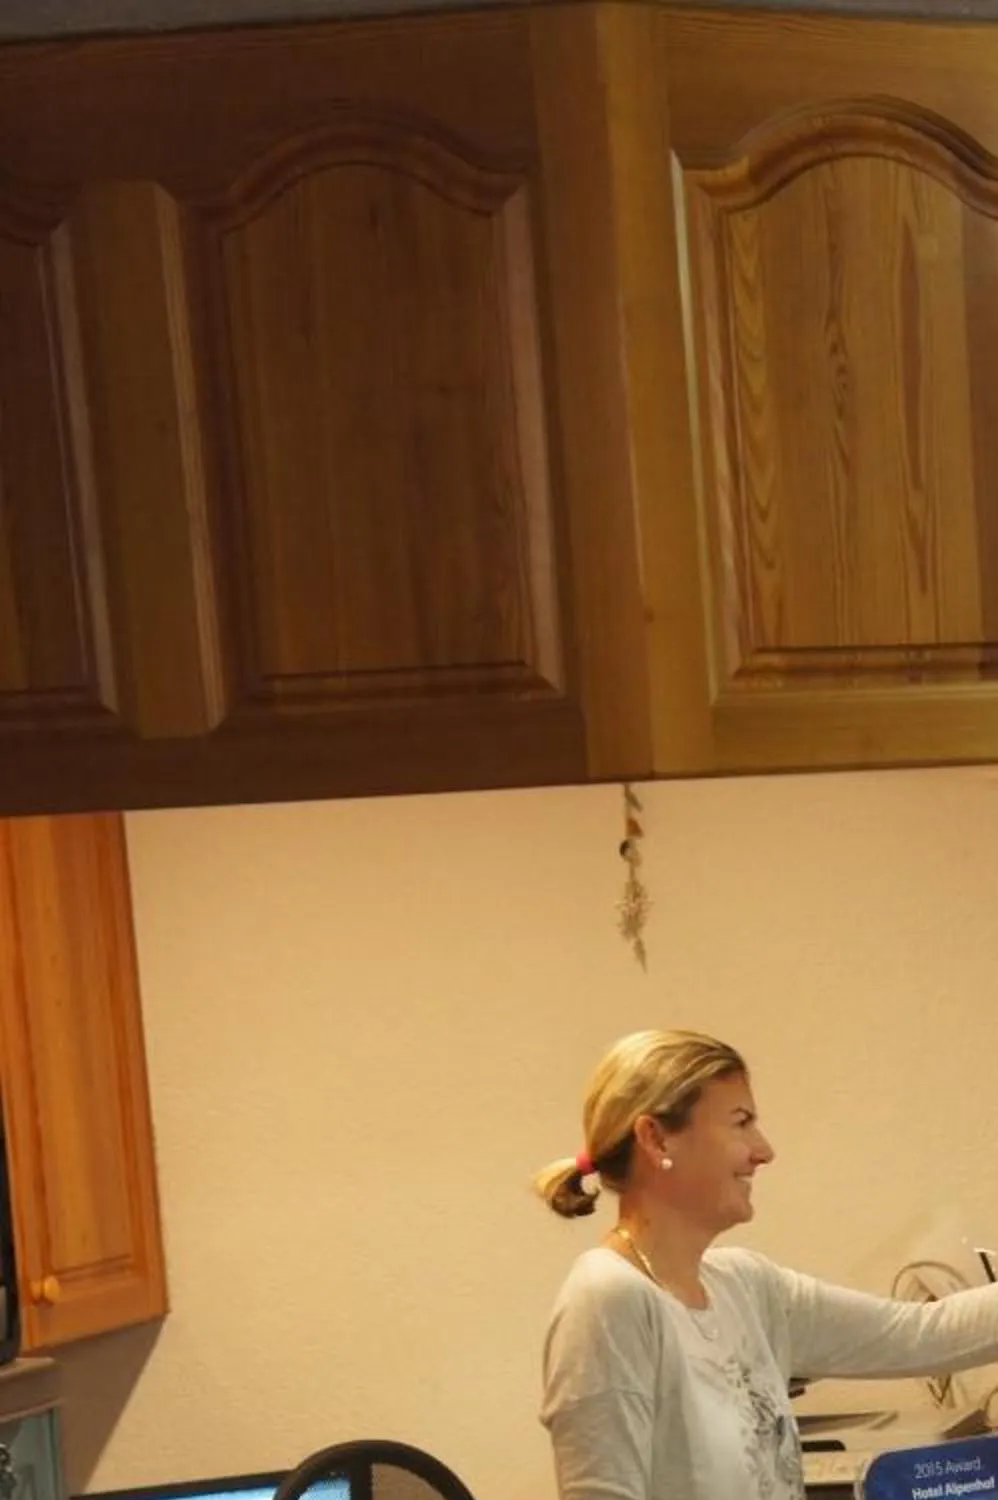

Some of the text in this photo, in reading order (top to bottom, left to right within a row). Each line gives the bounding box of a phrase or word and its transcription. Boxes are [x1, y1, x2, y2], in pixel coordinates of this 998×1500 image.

[914, 1456, 981, 1479] 2015 Award
[911, 1475, 995, 1500] Hotel Alpenhof
